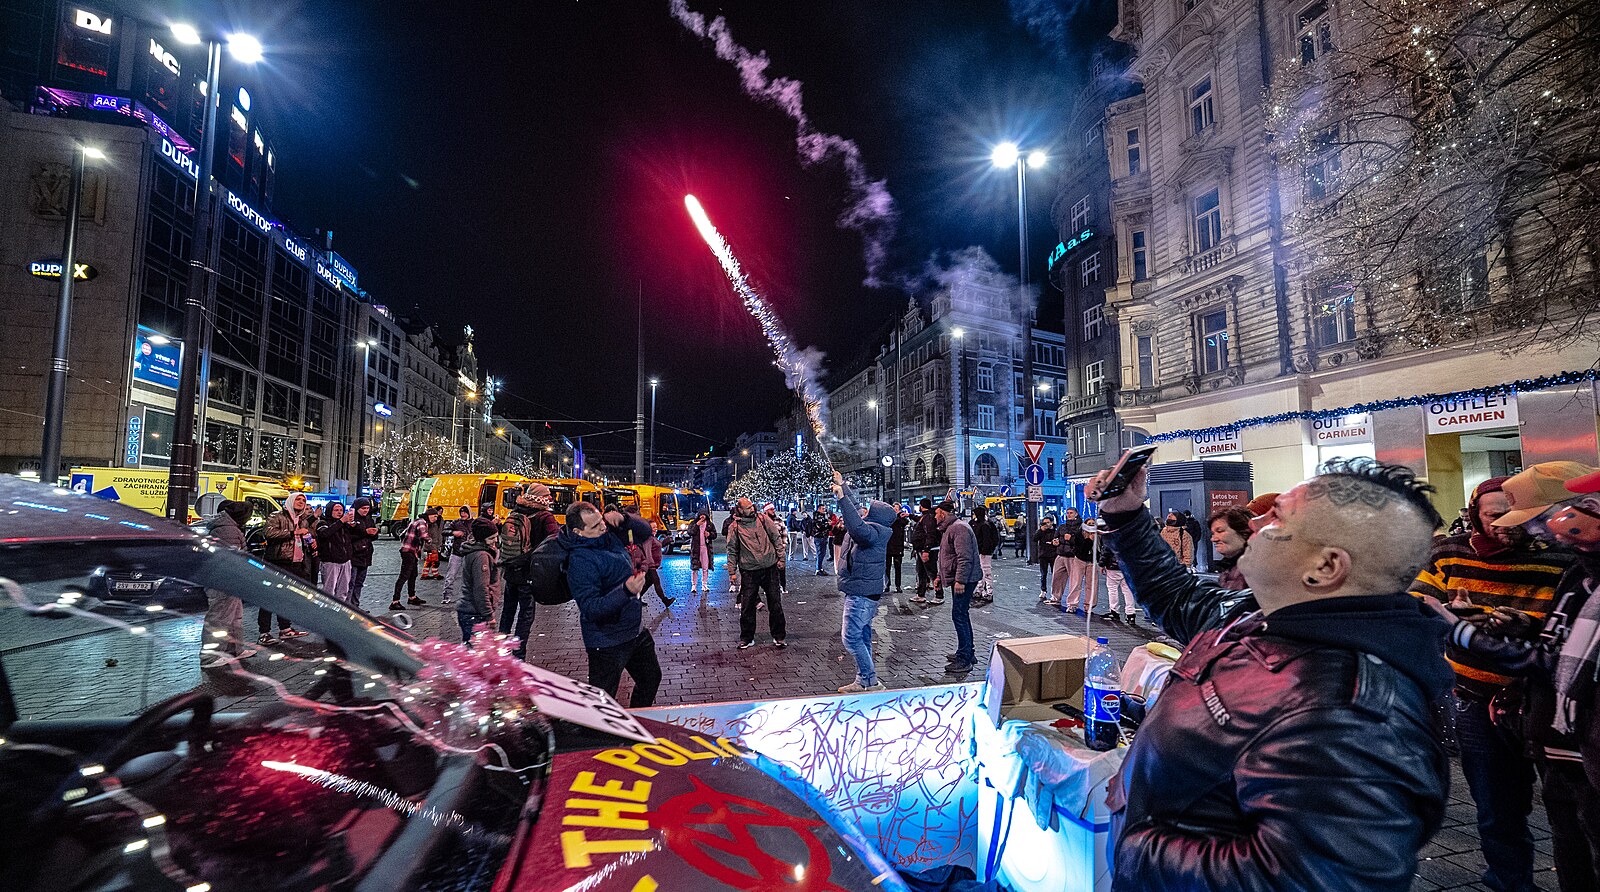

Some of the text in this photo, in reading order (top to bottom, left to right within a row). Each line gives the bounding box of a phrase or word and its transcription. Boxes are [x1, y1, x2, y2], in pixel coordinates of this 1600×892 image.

[228, 191, 273, 233] ROOFTOP
[286, 238, 306, 261] CLUB
[317, 263, 342, 291] DUPLEX
[1430, 394, 1508, 415] OUTLET
[1438, 410, 1505, 426] CARMEN
[1318, 427, 1366, 440] CARMEN
[1199, 442, 1237, 454] CARMEN
[560, 770, 656, 869] THE
